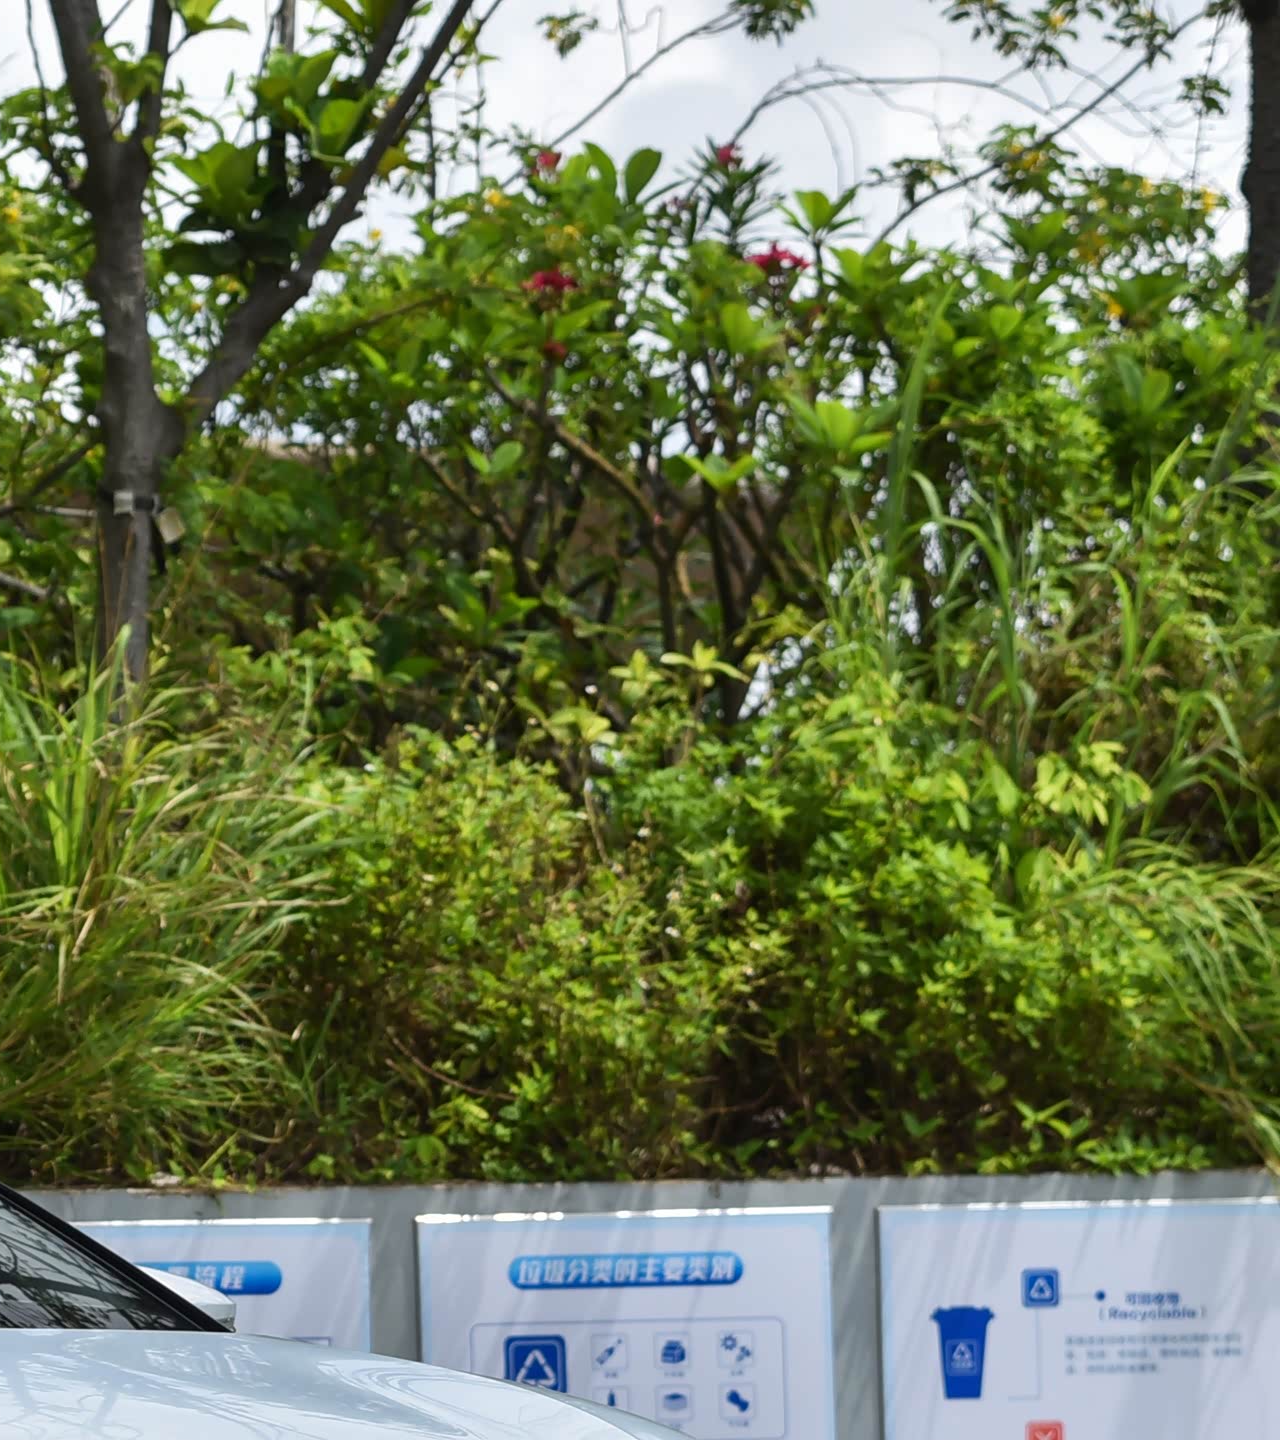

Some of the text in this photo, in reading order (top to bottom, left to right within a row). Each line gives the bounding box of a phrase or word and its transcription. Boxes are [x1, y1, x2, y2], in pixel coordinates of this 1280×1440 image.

[168, 1265, 245, 1290] 流程
[518, 1255, 734, 1285] 垃圾分类的主要类别
